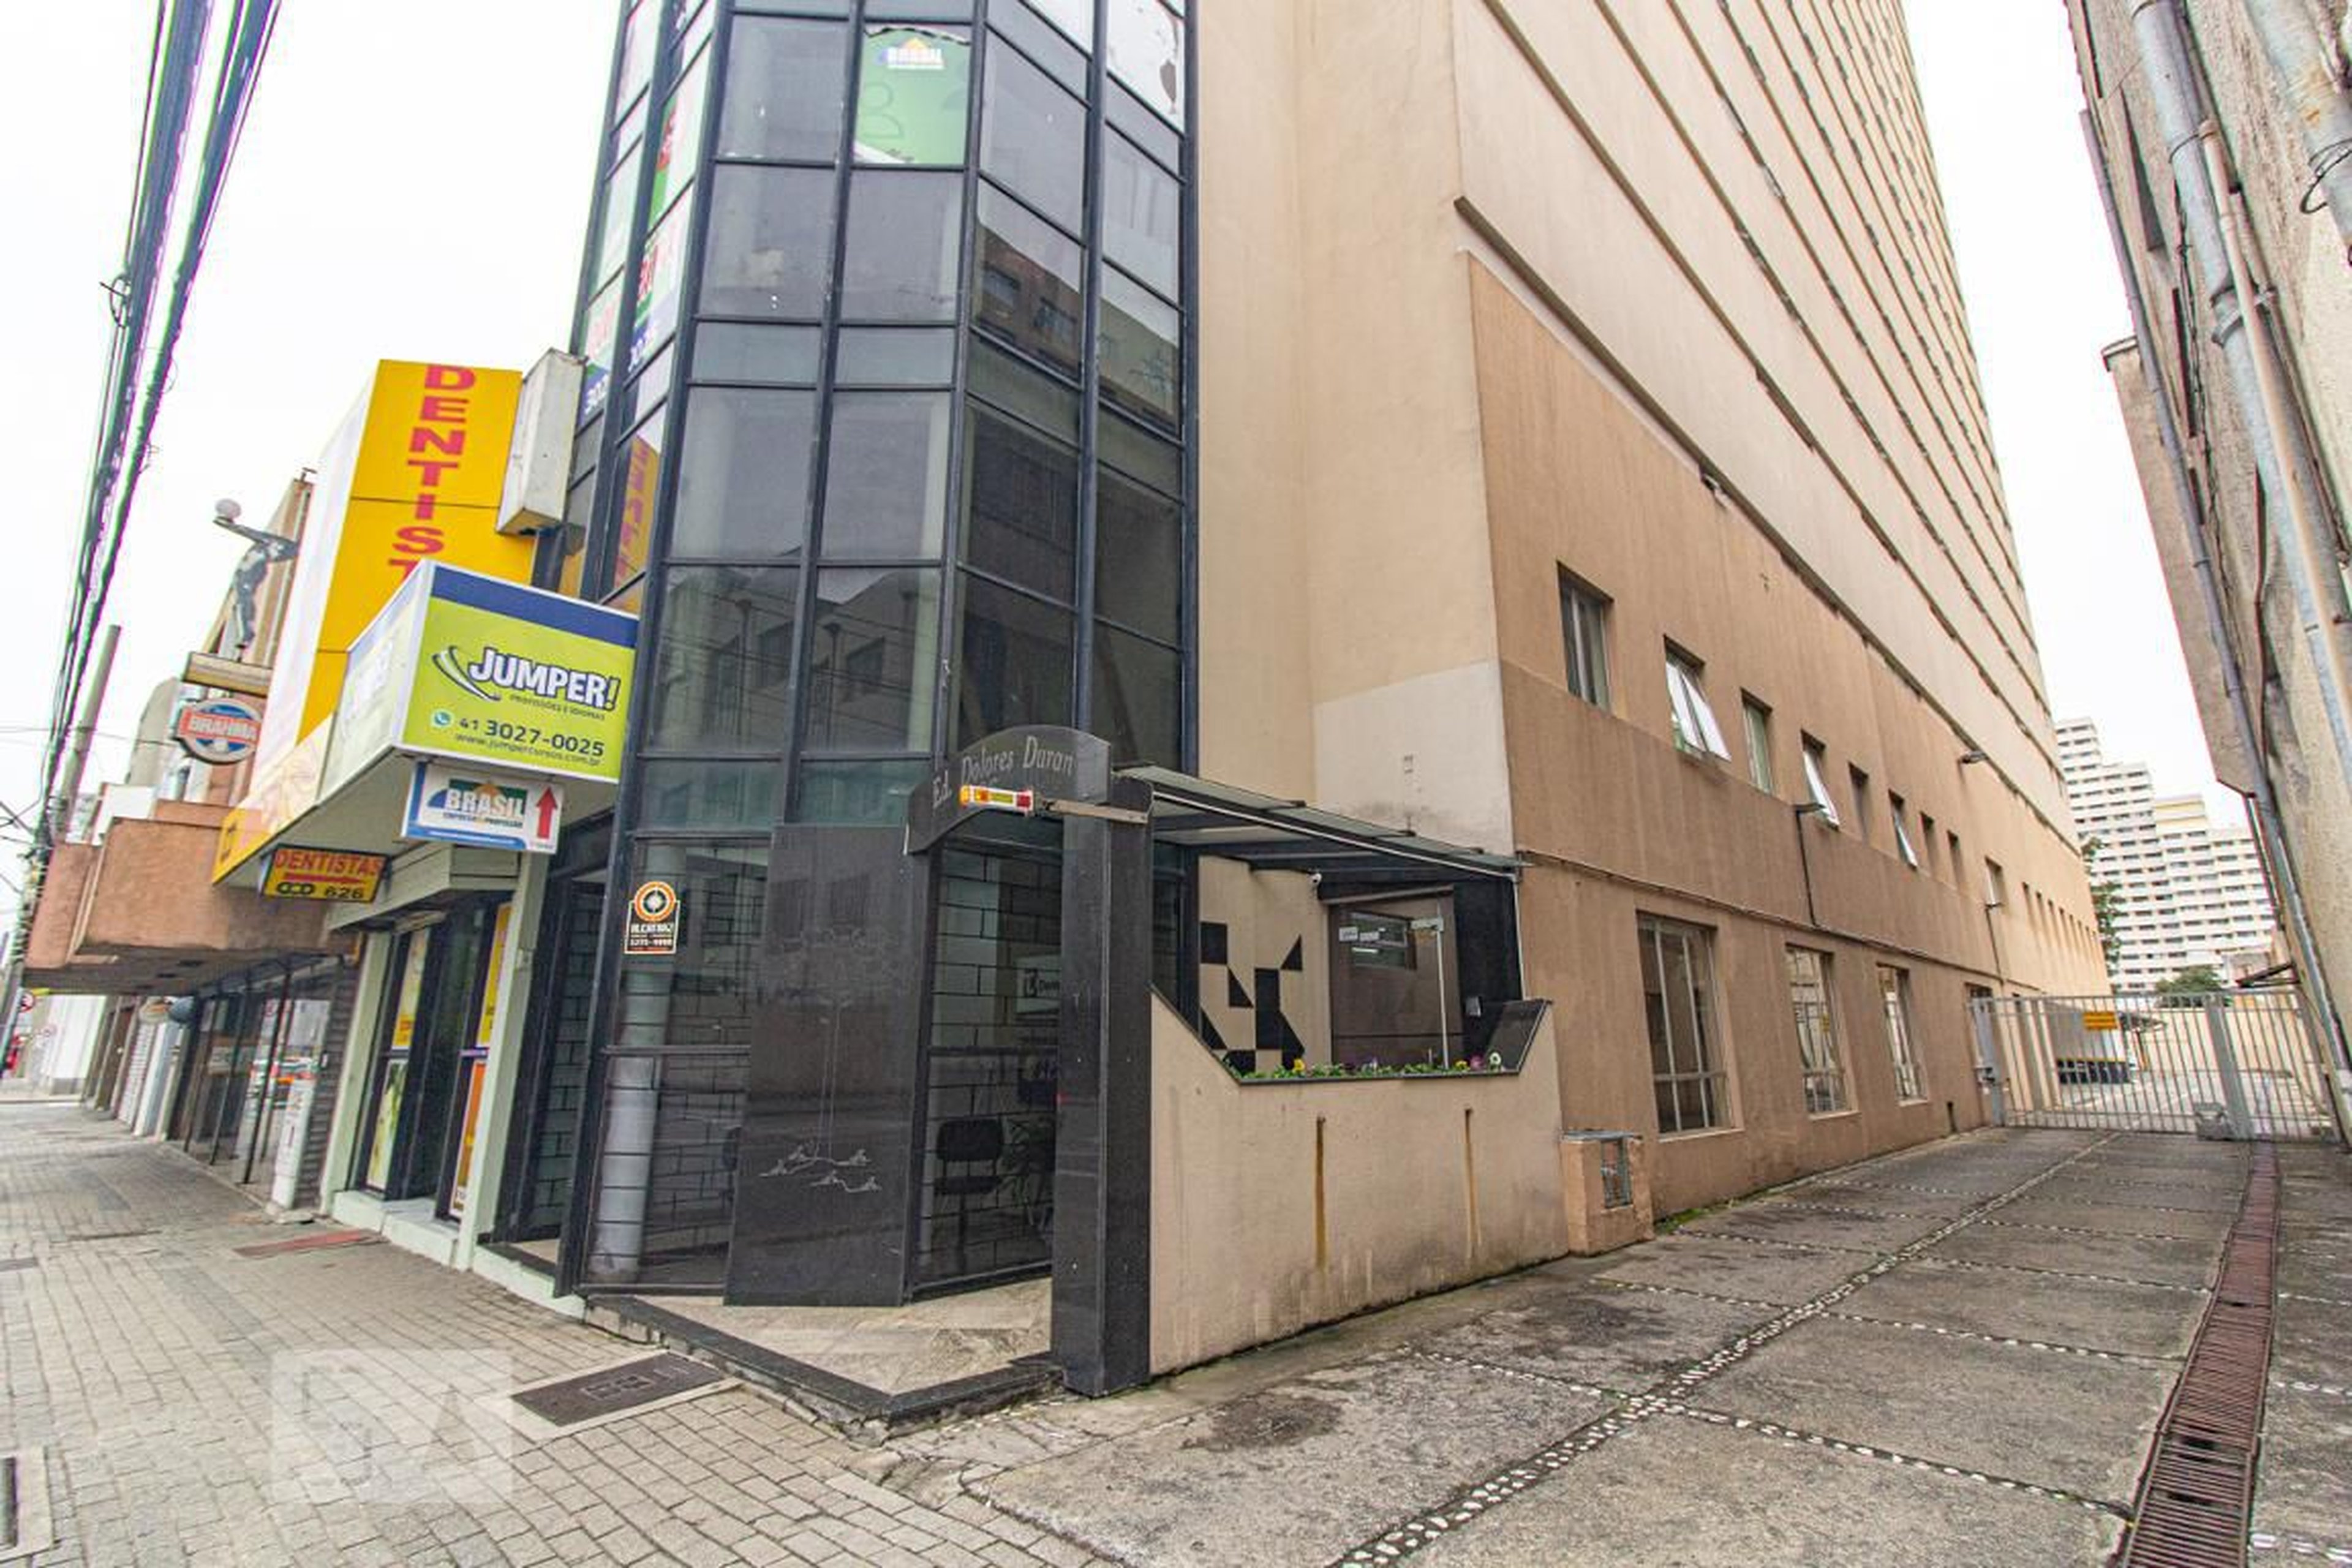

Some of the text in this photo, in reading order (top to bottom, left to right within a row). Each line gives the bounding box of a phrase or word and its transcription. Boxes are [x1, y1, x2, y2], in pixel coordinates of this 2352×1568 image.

[467, 647, 620, 712] JUMPER!
[459, 718, 605, 757] 41 3027-0025
[961, 747, 1014, 786] Dolores
[1022, 736, 1075, 778] Duran
[445, 789, 526, 818] BRASIL
[274, 848, 382, 877] DENTISTAS
[325, 885, 364, 899] 626
